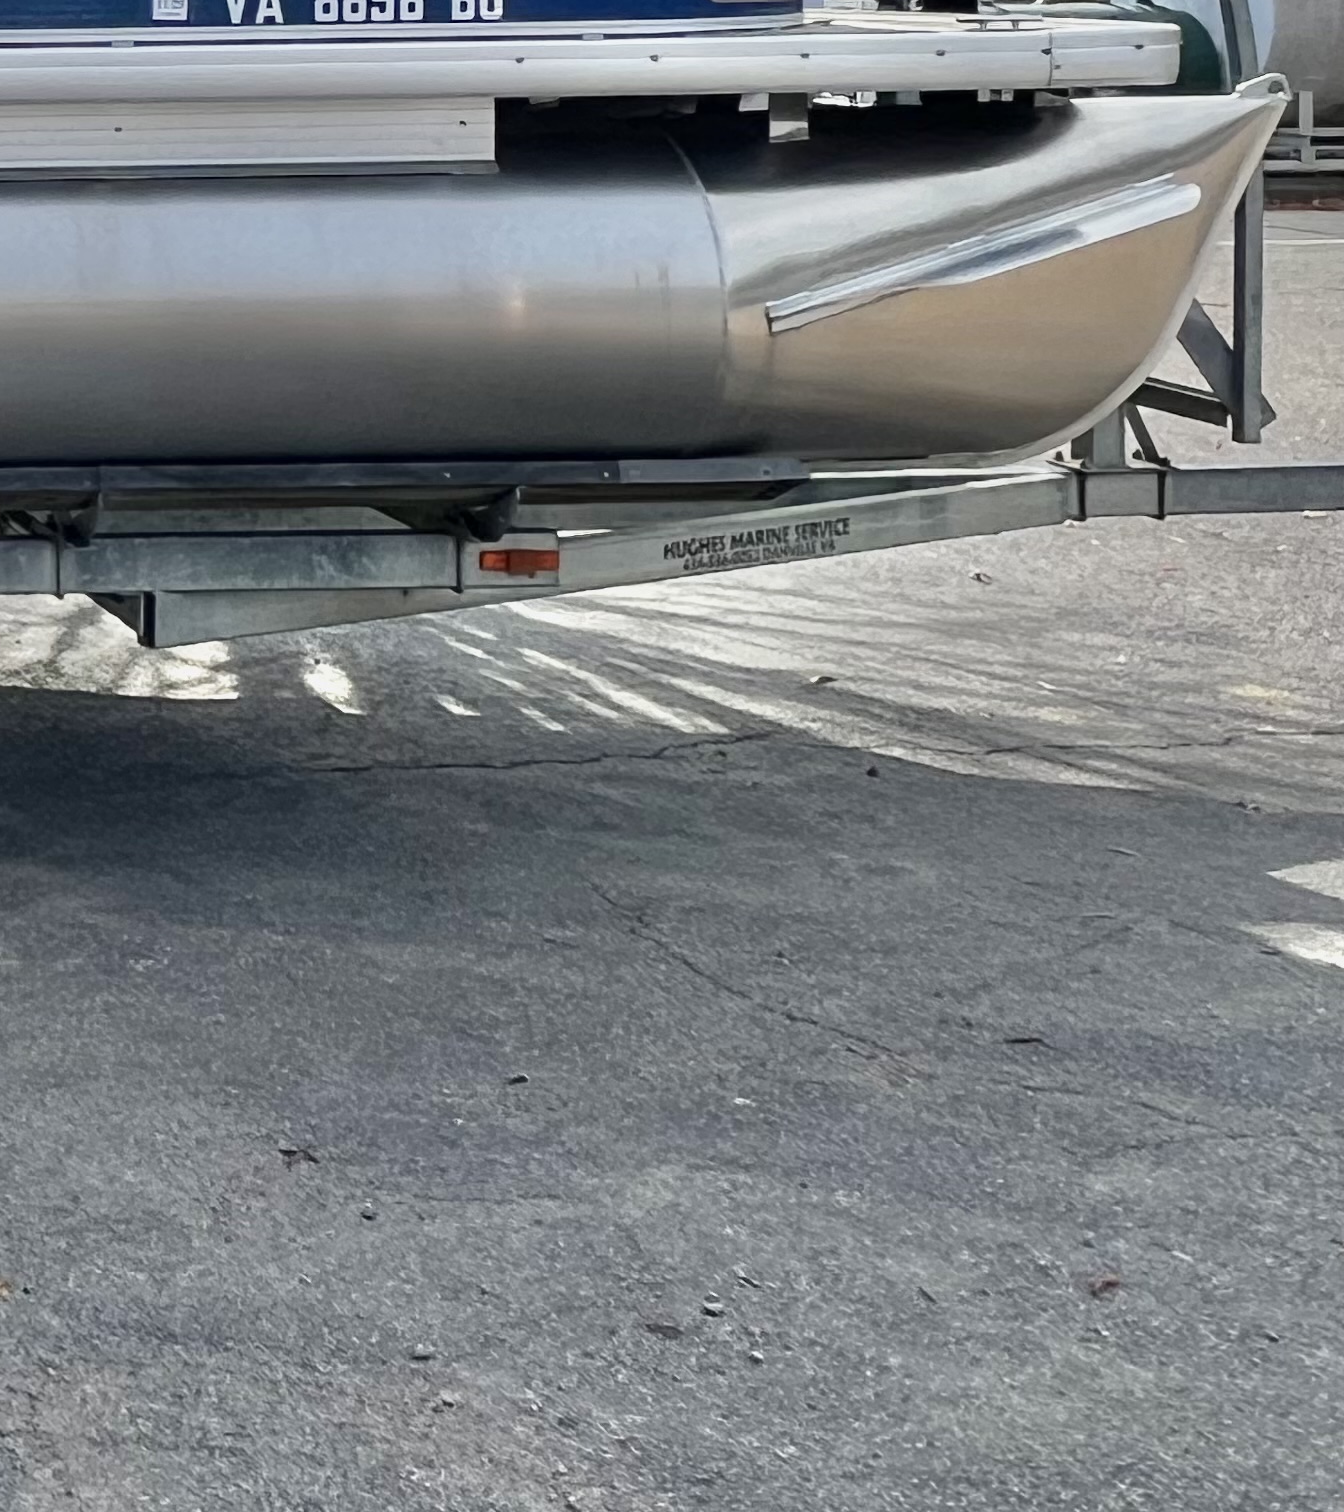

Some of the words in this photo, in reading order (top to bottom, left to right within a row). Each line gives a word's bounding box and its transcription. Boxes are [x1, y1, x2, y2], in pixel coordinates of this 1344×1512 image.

[663, 535, 726, 560] HUGHES
[730, 525, 790, 550] MARINE
[794, 517, 851, 540] SERVICE
